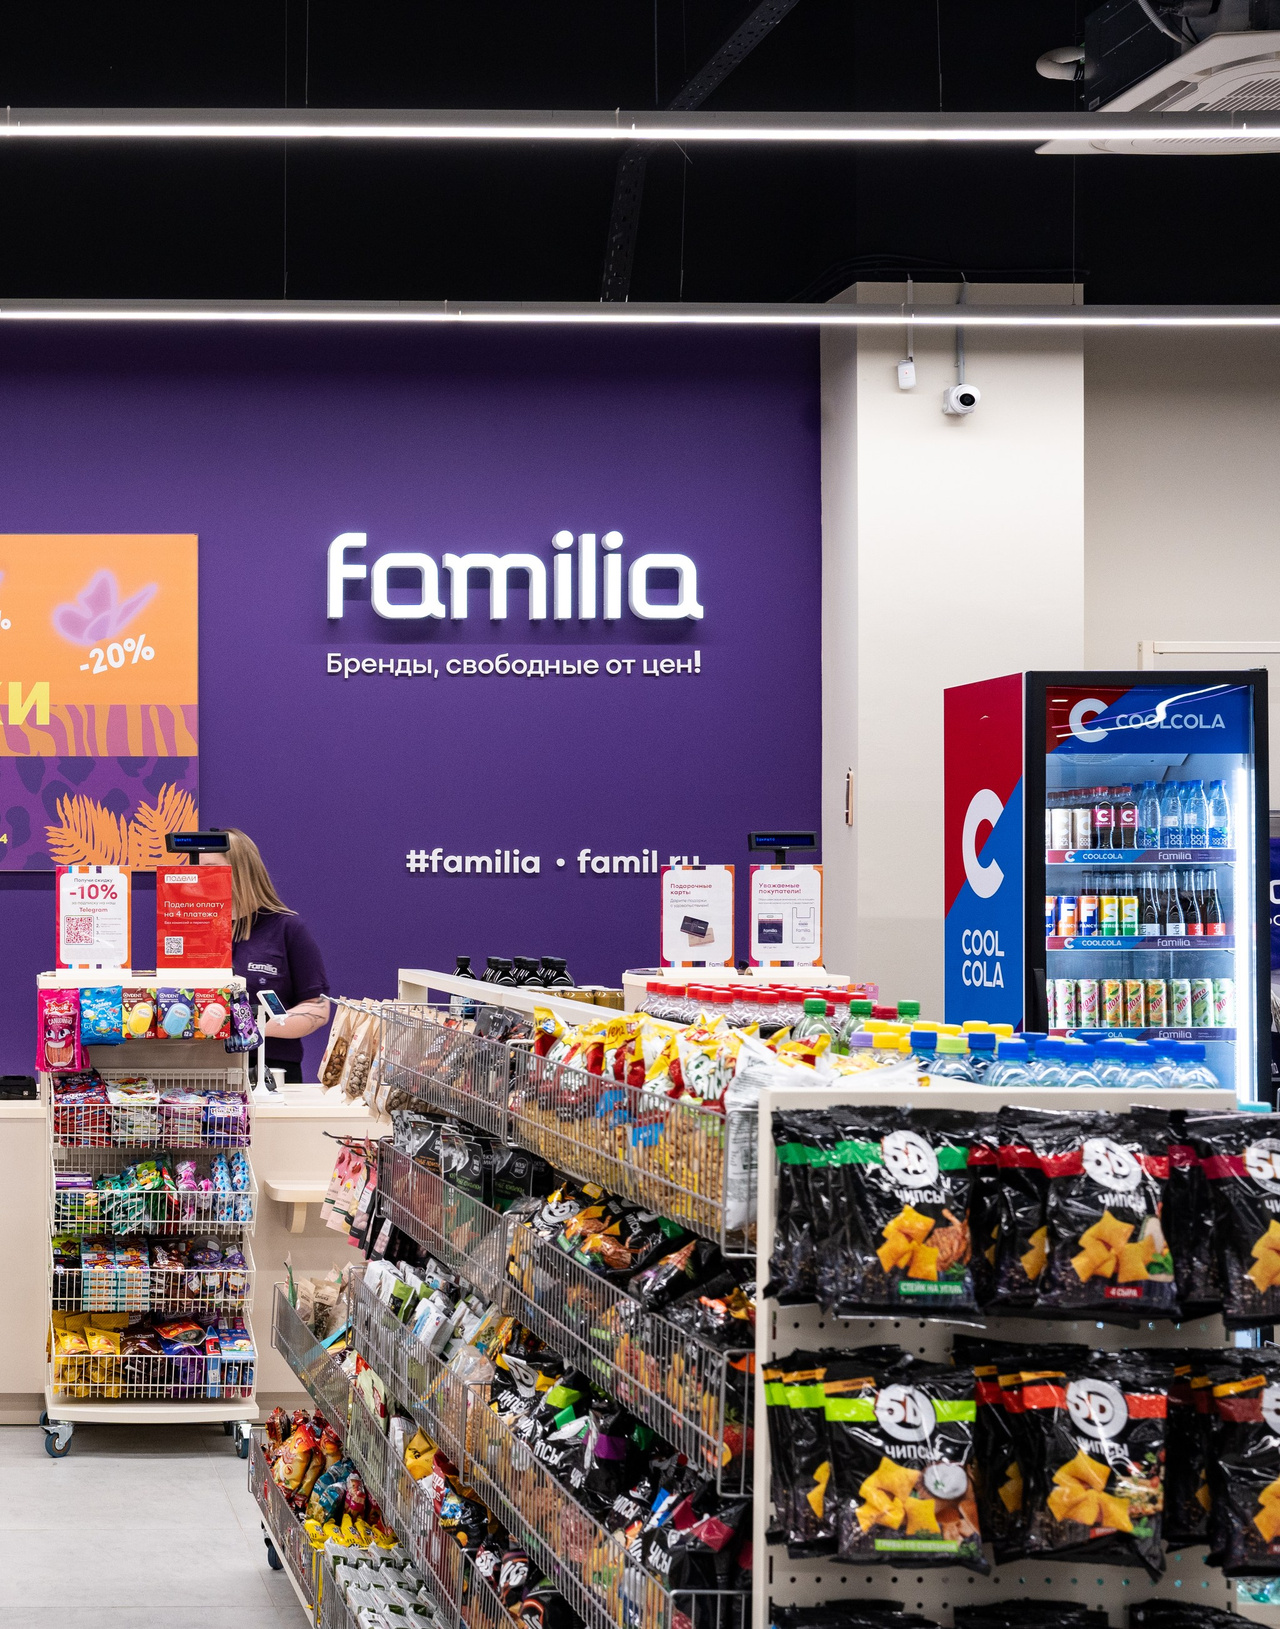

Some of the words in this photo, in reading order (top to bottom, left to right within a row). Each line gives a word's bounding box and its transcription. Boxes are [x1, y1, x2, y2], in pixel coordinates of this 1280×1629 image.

[327, 531, 704, 621] familia
[79, 634, 156, 675] -20%
[327, 653, 439, 679] Бренды,
[446, 654, 599, 677] свободные
[605, 658, 636, 675] от
[643, 650, 702, 676] цен!
[1116, 713, 1226, 730] COOLCOLA
[406, 848, 541, 874] #familia
[577, 848, 700, 874] familru
[1158, 851, 1192, 860] familia
[69, 884, 118, 900] -10%
[961, 929, 1005, 958] COOL
[1157, 938, 1191, 947] familia
[247, 961, 278, 975] familia
[961, 959, 1004, 989] COLA
[1159, 1030, 1192, 1039] familia
[895, 1190, 946, 1204] ЧИПСЫ
[1098, 1194, 1148, 1209] ЧИПСЫ
